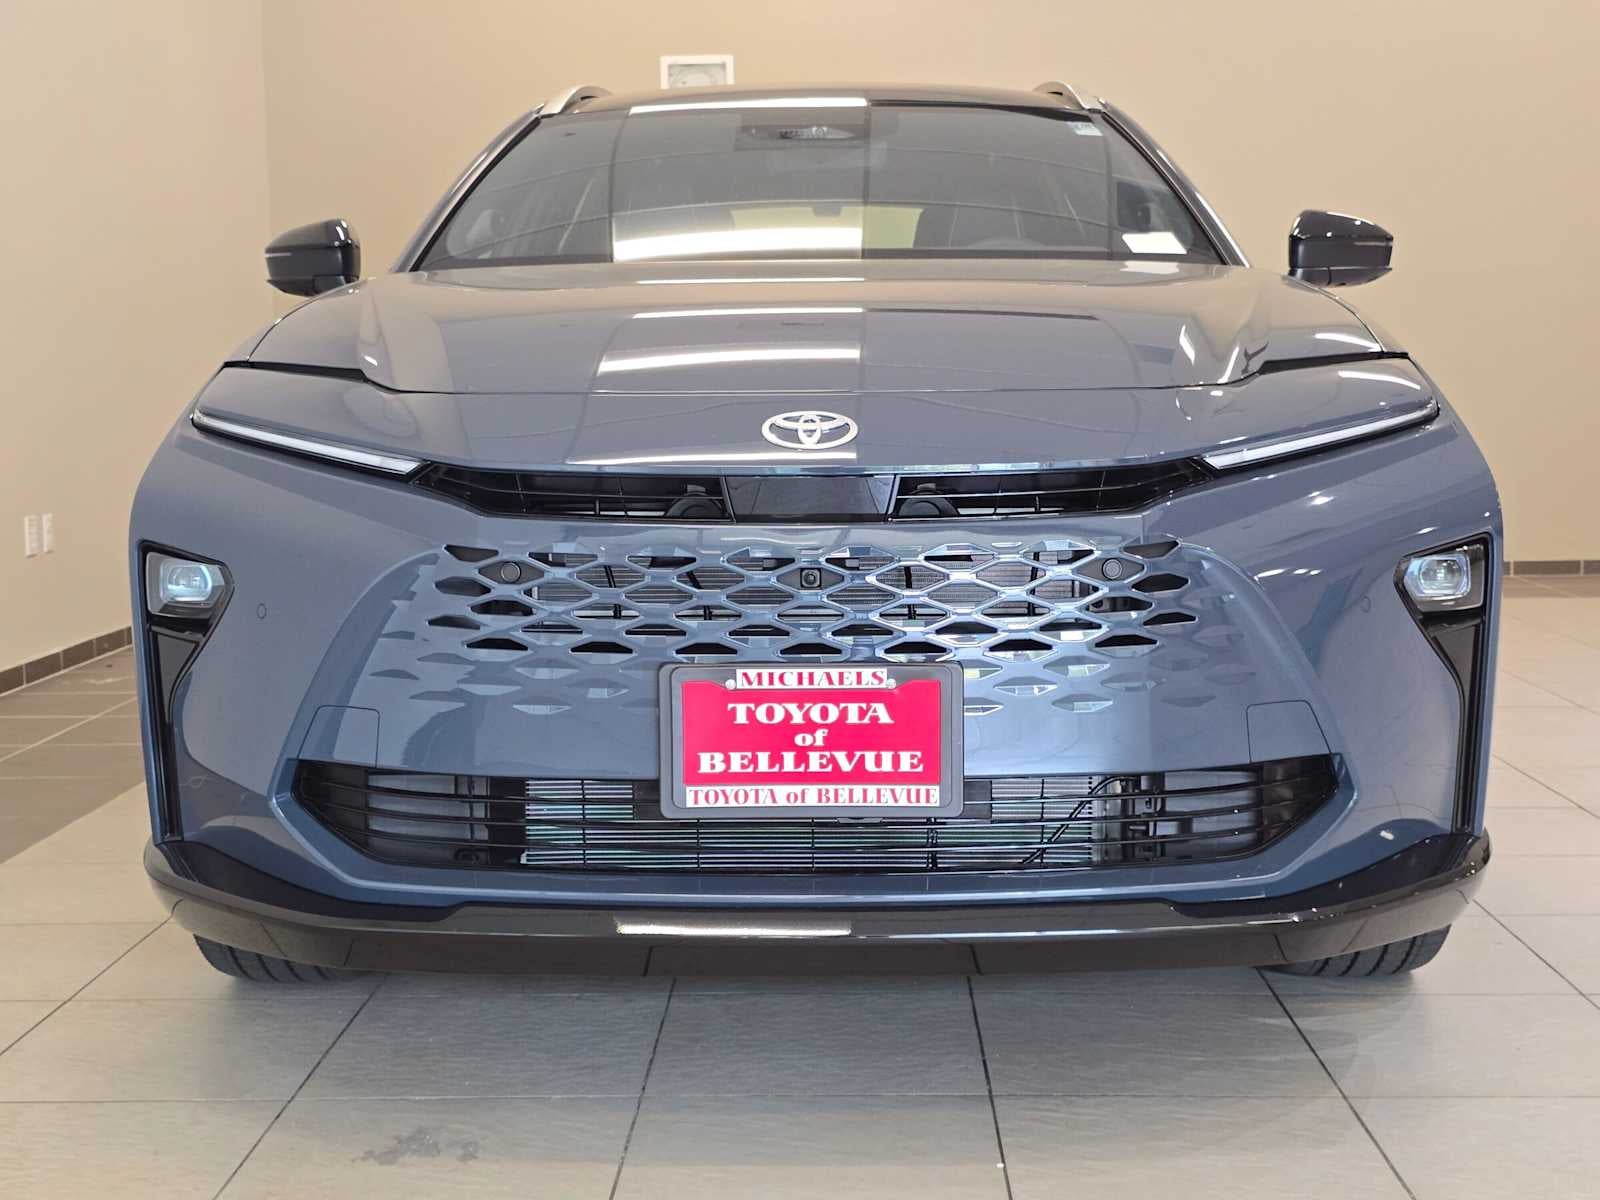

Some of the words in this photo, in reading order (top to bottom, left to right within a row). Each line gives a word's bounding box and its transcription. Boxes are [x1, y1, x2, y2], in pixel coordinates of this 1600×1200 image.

[741, 671, 884, 687] MICHAELS
[728, 703, 895, 724] TOYOTA
[794, 729, 829, 747] of
[697, 751, 923, 773] BELLEVUE
[689, 788, 779, 806] TOYOTA
[786, 788, 809, 804] of
[817, 787, 938, 805] BELLEVUE
